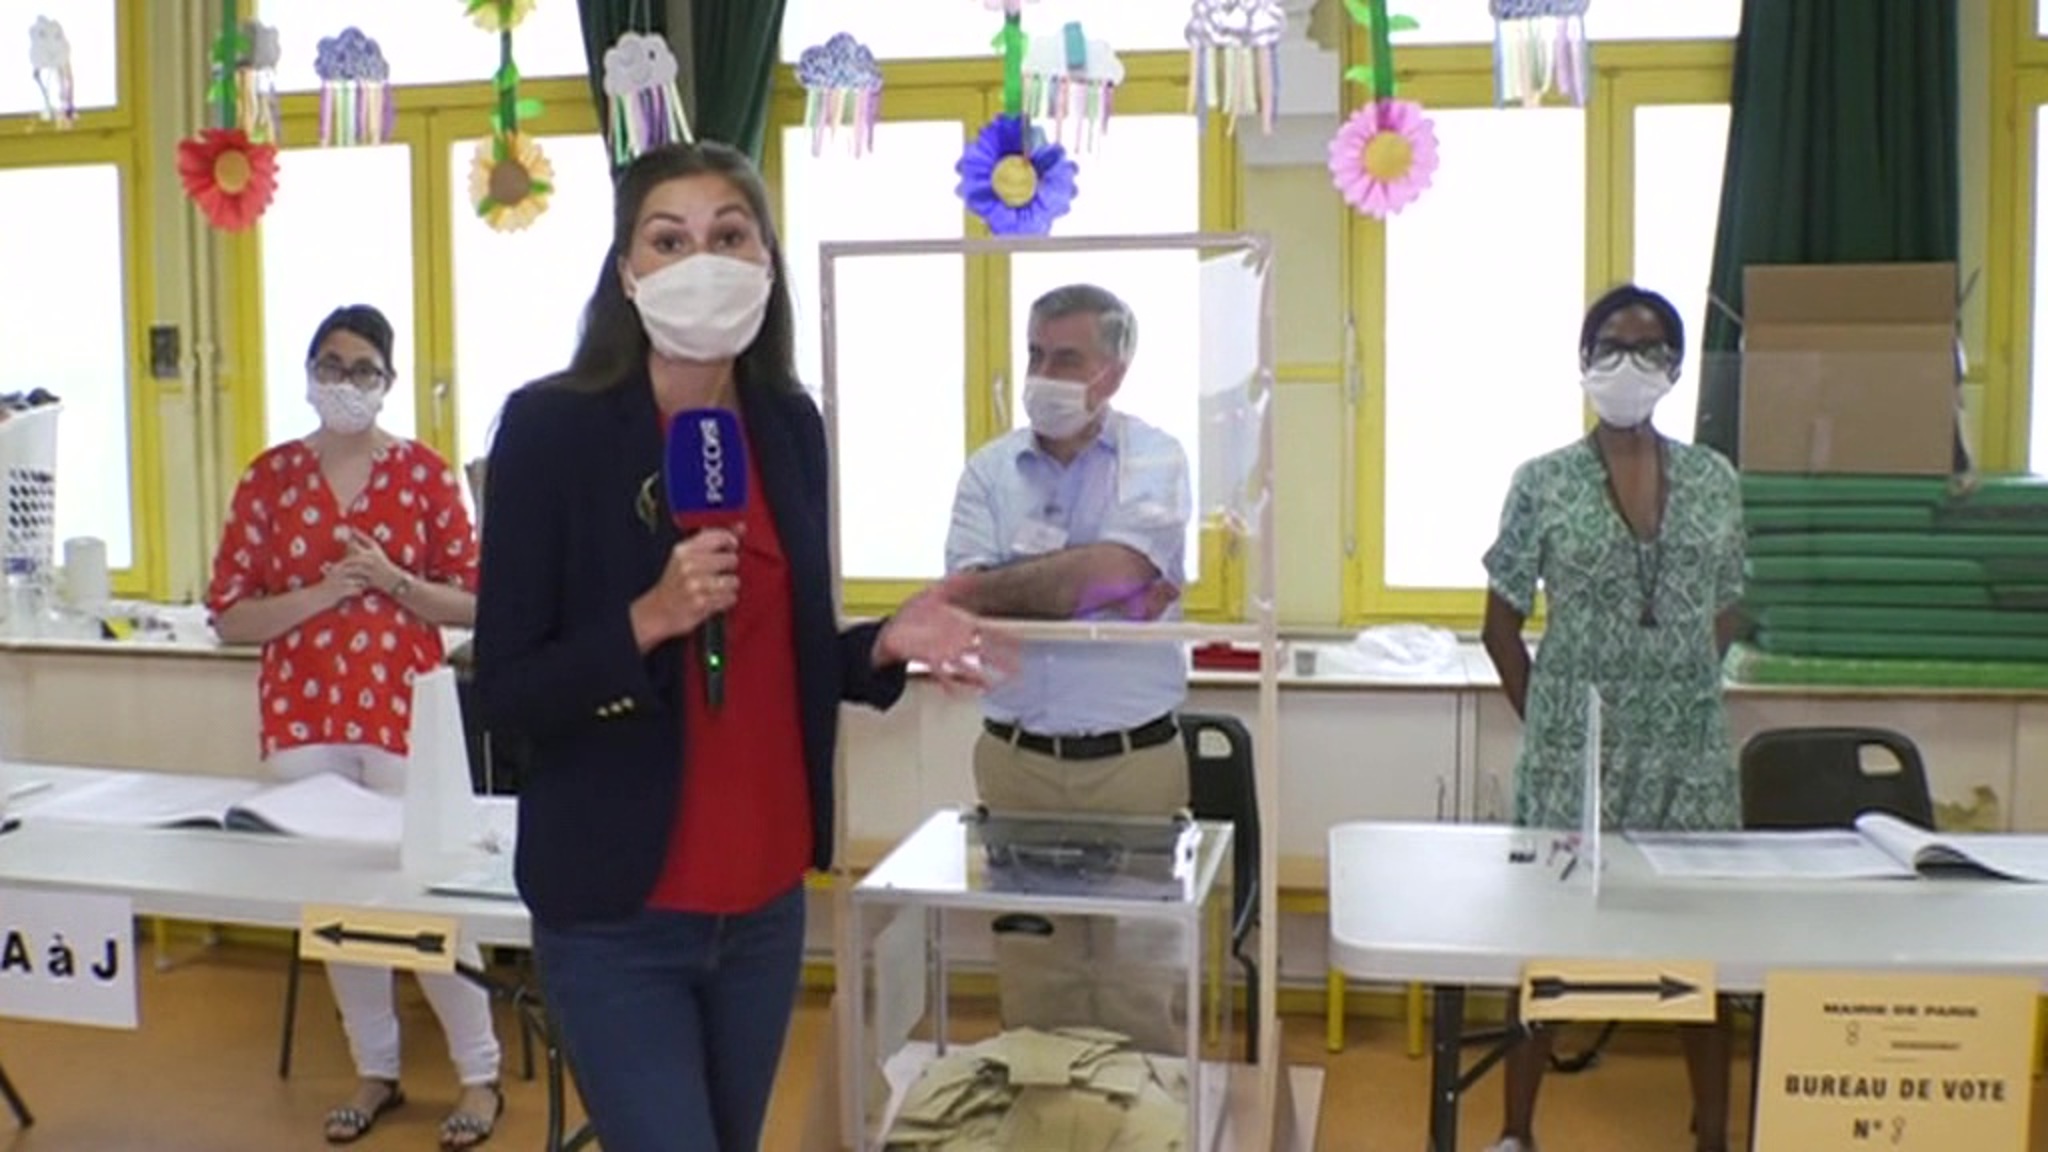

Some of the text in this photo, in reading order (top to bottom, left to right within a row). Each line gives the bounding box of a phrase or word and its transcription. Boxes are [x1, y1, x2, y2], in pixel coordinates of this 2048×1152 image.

[1, 930, 117, 980] A à J
[1893, 1004, 1917, 1016] DE
[1924, 1005, 1978, 1017] PARIS
[1785, 1074, 2006, 1101] BUREAU DE VOTE
[1853, 1119, 1882, 1140] N°
